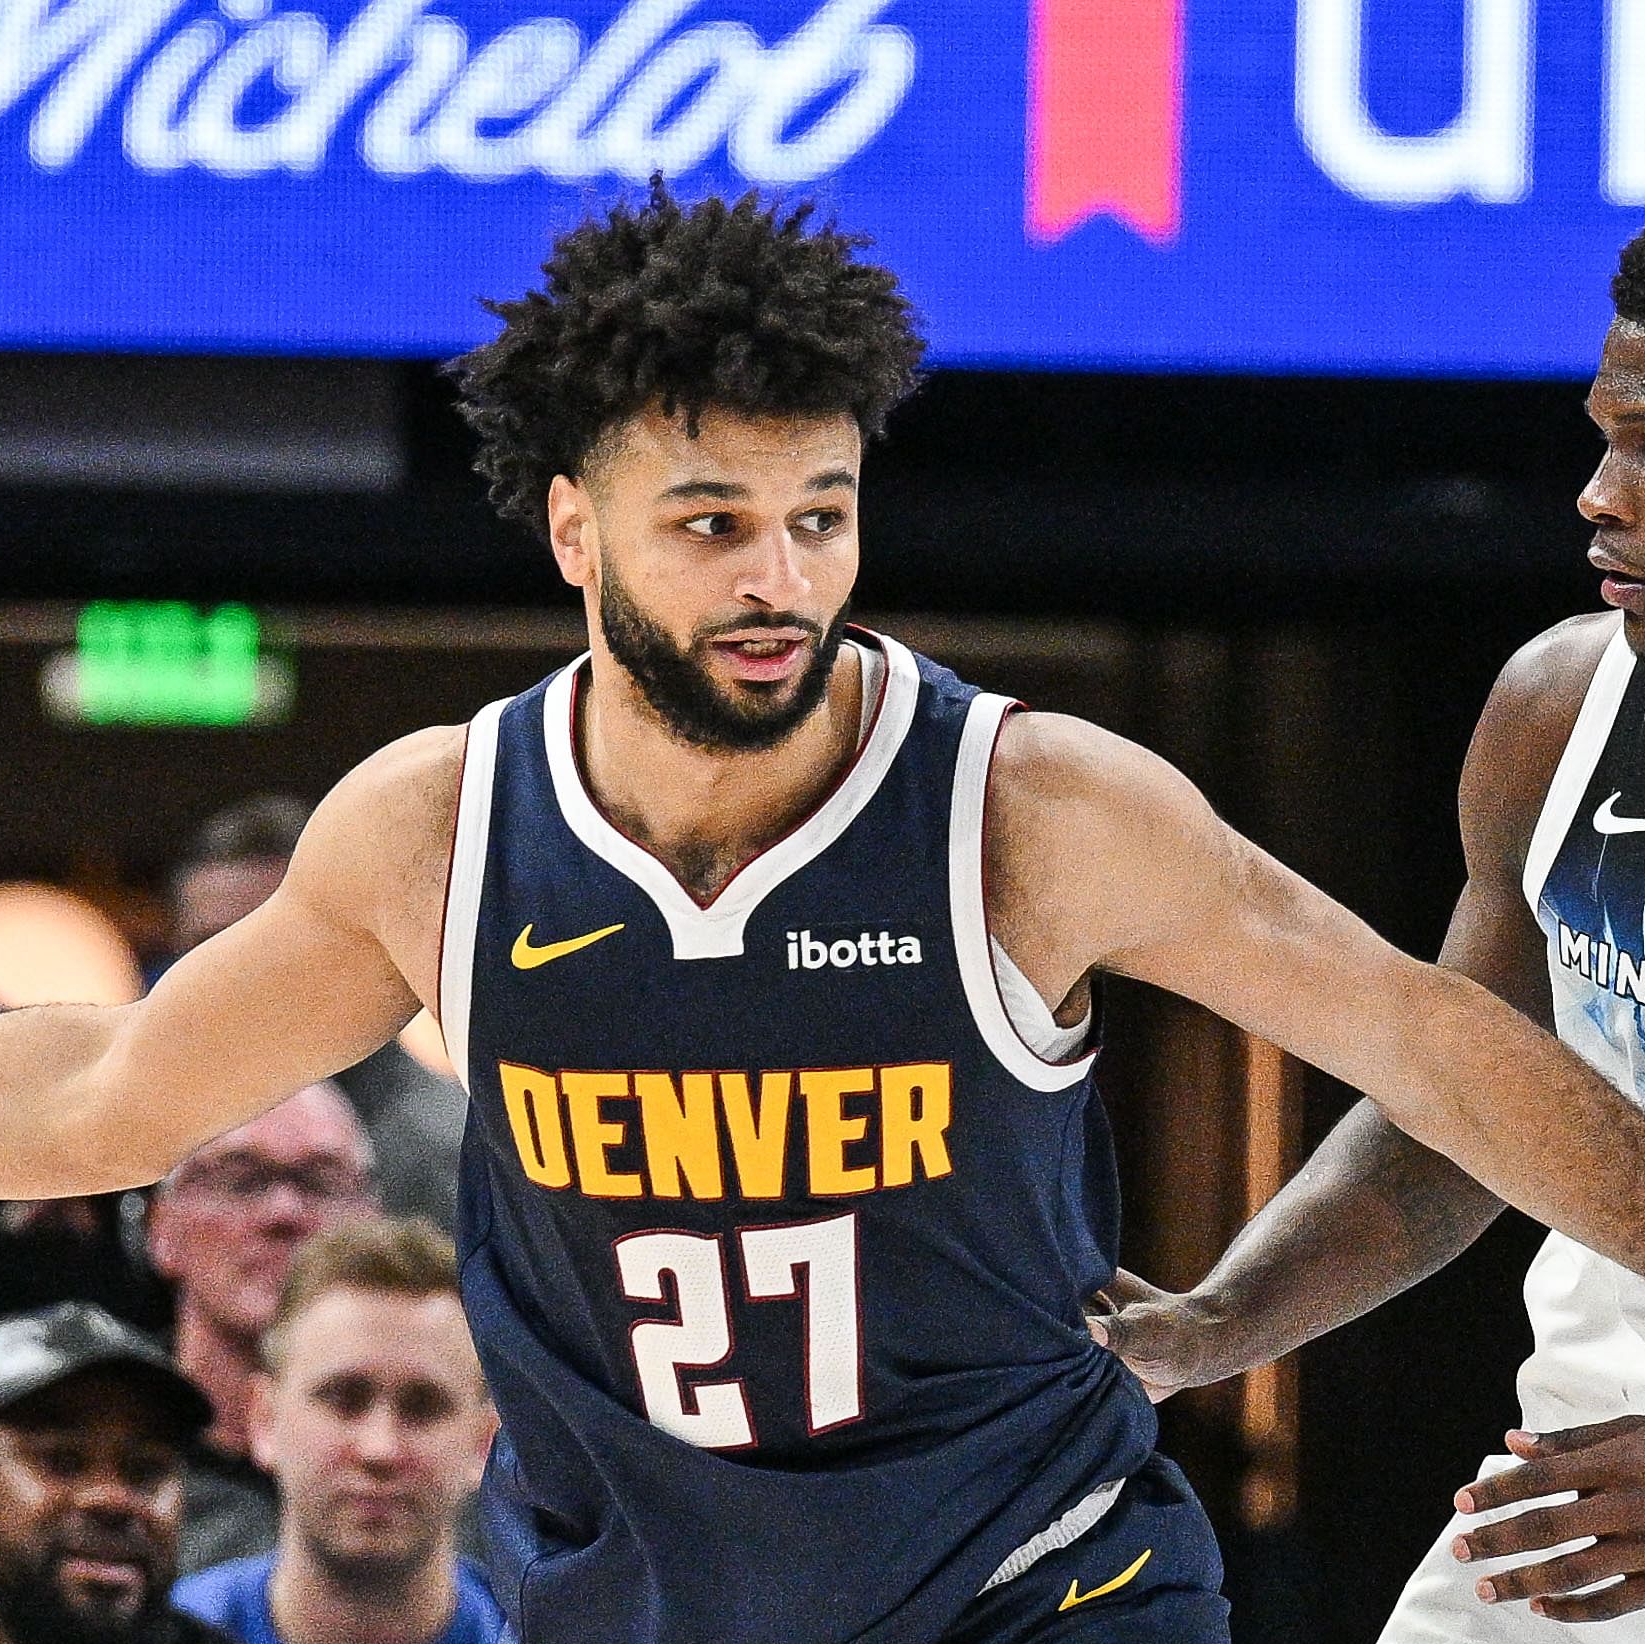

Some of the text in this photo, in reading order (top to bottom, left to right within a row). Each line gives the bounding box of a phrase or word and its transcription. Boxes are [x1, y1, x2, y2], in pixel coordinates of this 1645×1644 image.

[786, 930, 923, 970] ibotta
[497, 1059, 954, 1201] DENVER
[611, 1210, 865, 1453] 27
